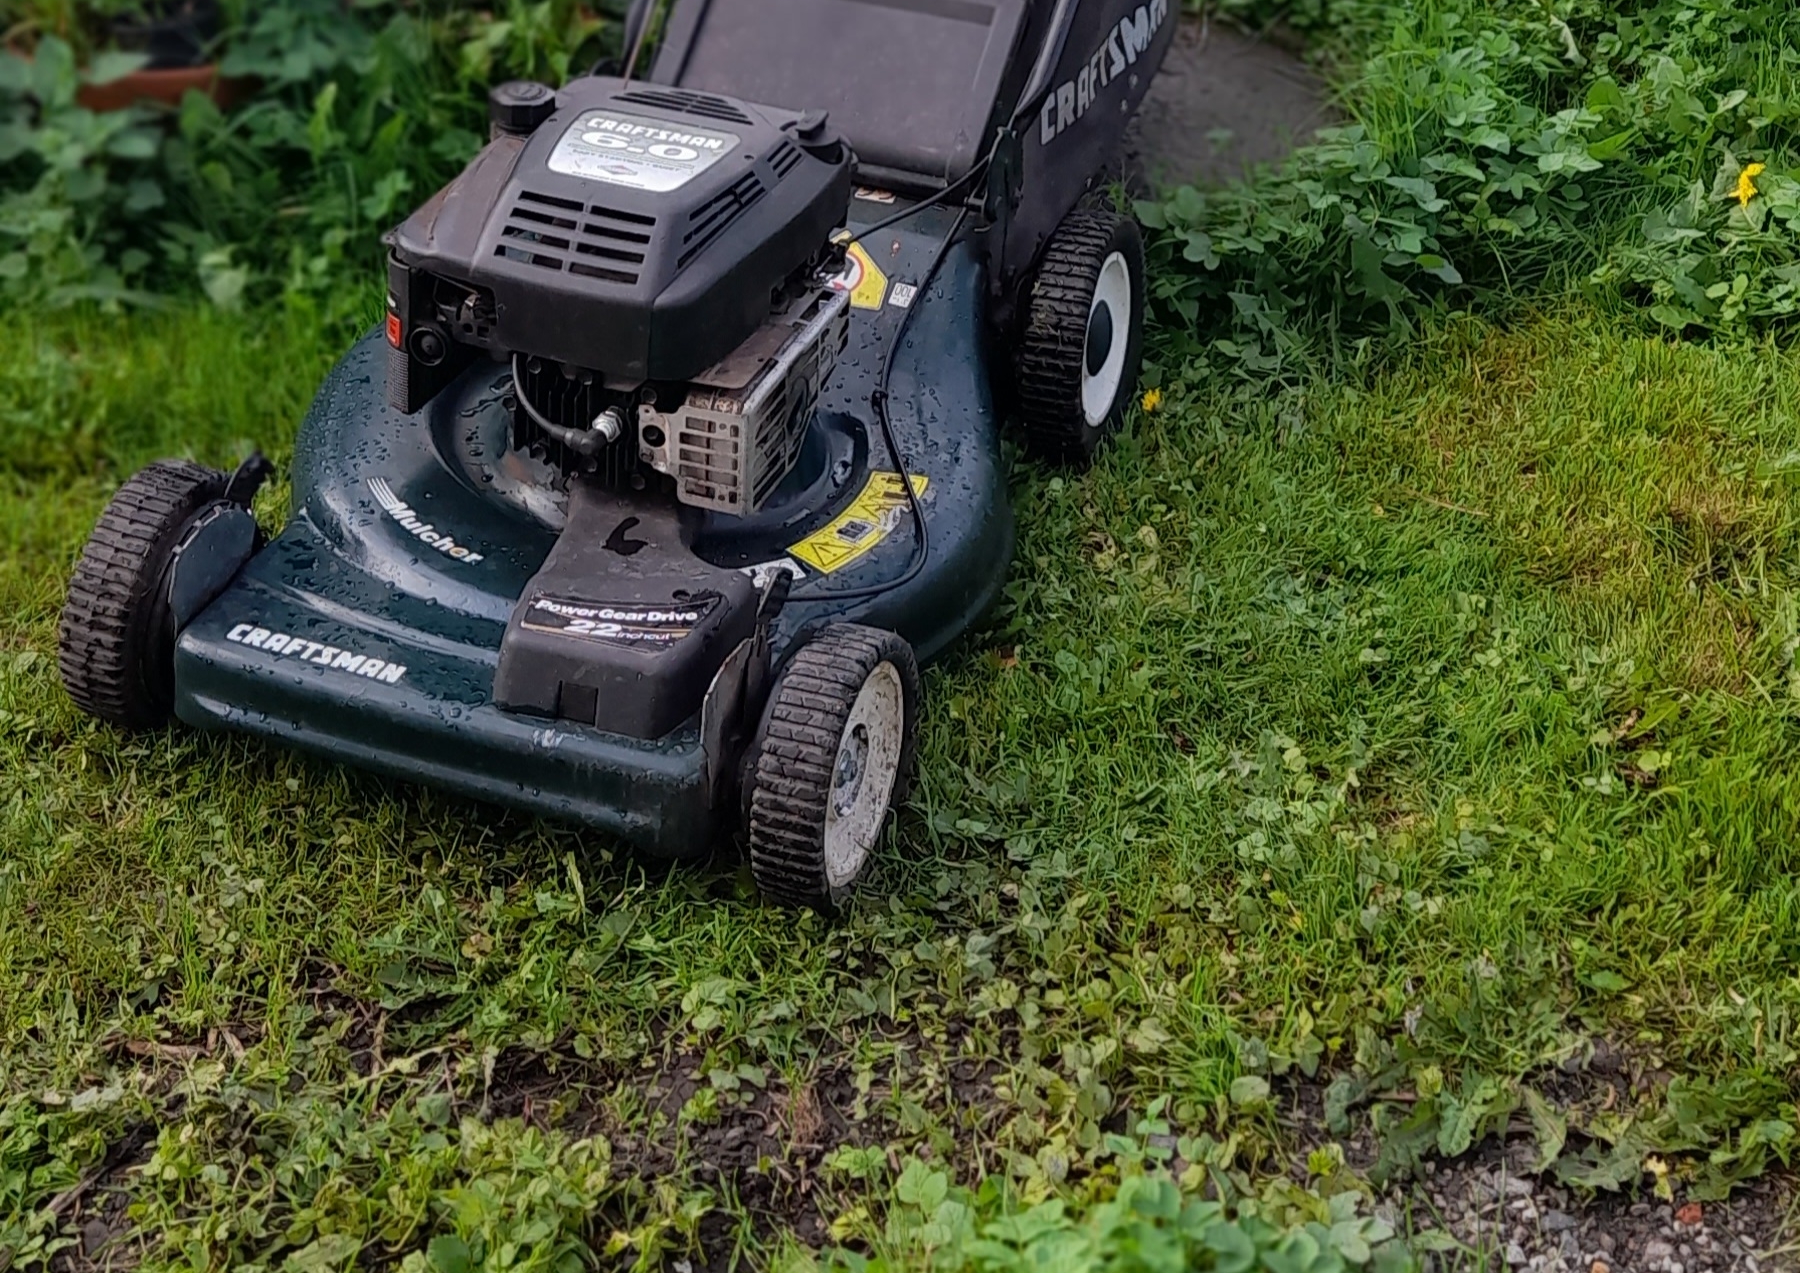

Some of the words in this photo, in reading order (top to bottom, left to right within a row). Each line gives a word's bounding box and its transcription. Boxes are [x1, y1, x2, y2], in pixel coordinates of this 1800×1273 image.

[581, 131, 700, 161] 6.0
[586, 117, 723, 150] CRAFTSMAN
[385, 500, 484, 563] Mulcher
[563, 619, 622, 638] 22
[226, 623, 407, 684] CRAFTSMAN
